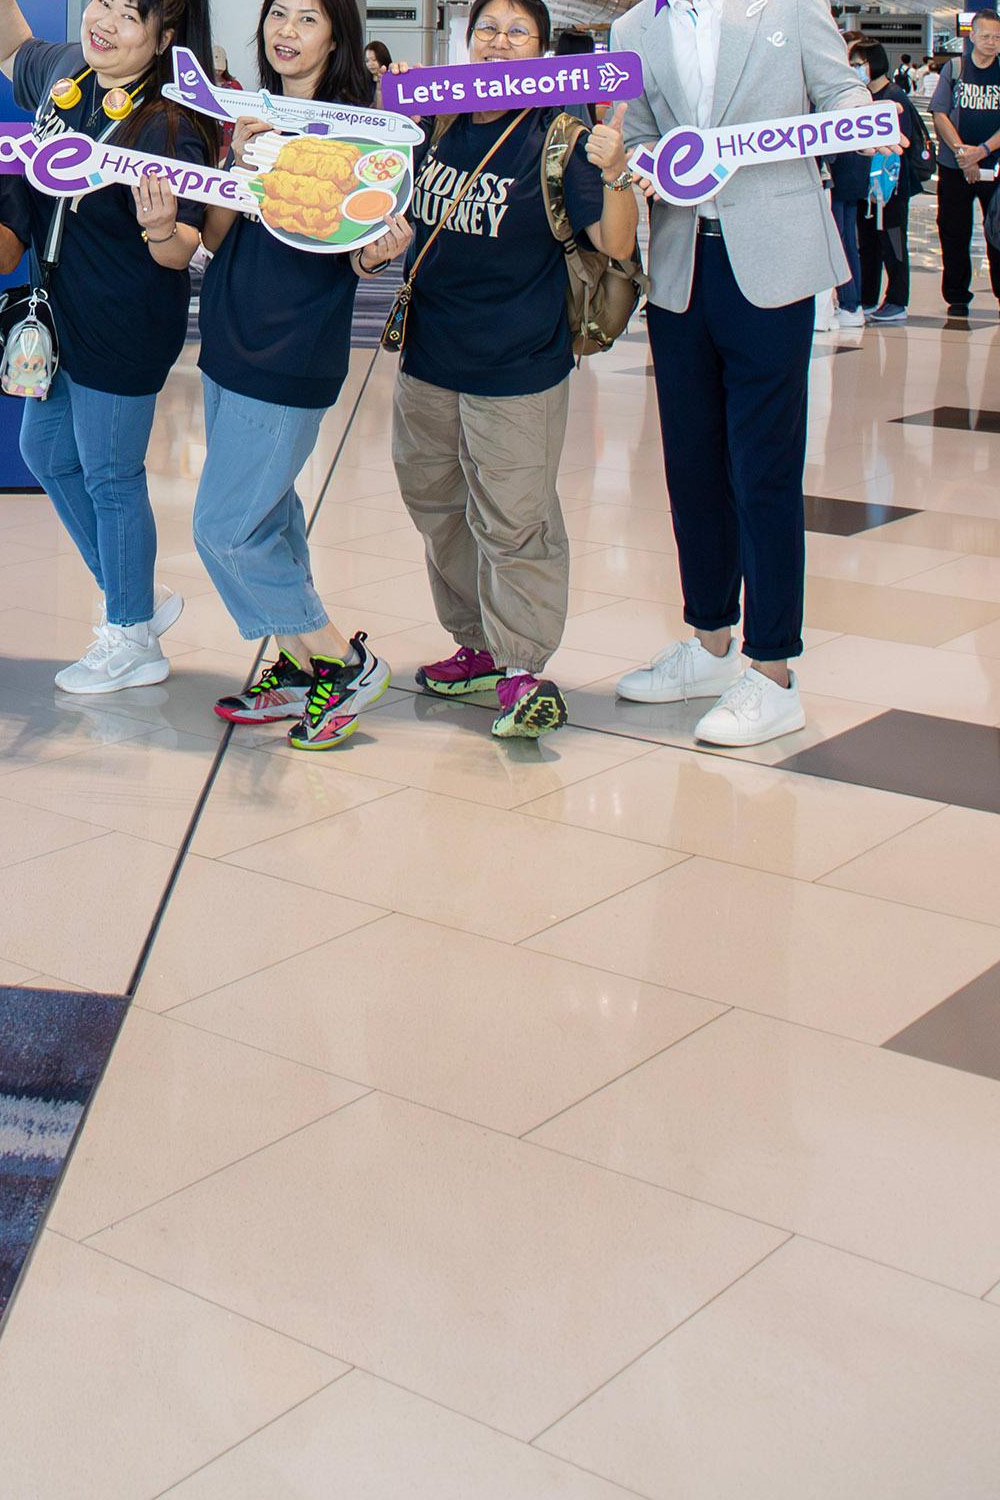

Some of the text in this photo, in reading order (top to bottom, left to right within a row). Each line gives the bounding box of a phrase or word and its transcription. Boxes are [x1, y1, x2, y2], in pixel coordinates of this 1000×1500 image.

[396, 68, 591, 105] Let's takeoff!
[960, 95, 1000, 110] OURNE
[320, 109, 387, 127] HKexpress
[716, 112, 893, 158] HKexpress
[100, 152, 250, 200] HKexpre
[411, 186, 508, 238] OURNEY
